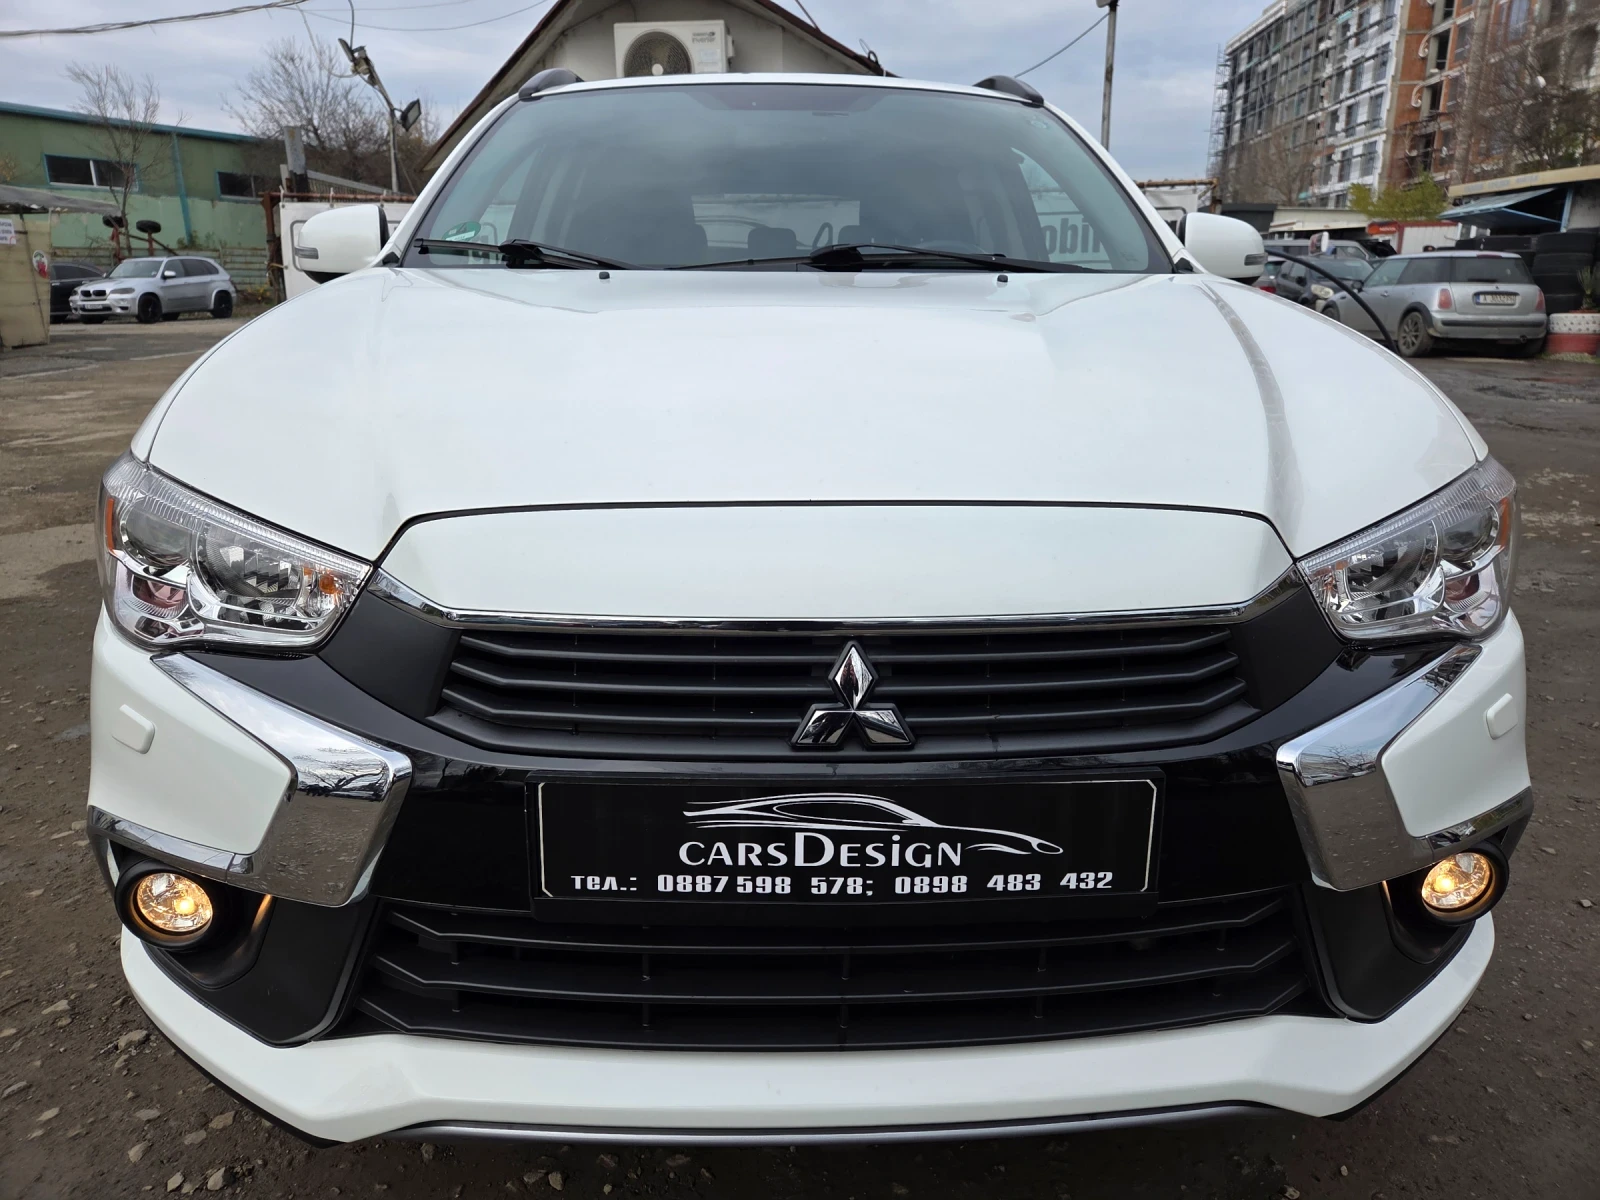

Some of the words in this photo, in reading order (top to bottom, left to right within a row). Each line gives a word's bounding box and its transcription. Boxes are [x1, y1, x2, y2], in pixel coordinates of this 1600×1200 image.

[657, 874, 729, 893] 0887
[736, 875, 792, 894] 598
[810, 876, 874, 896] 578;
[894, 875, 968, 894] 0898
[986, 873, 1041, 892] 483
[1059, 871, 1113, 890] 432
